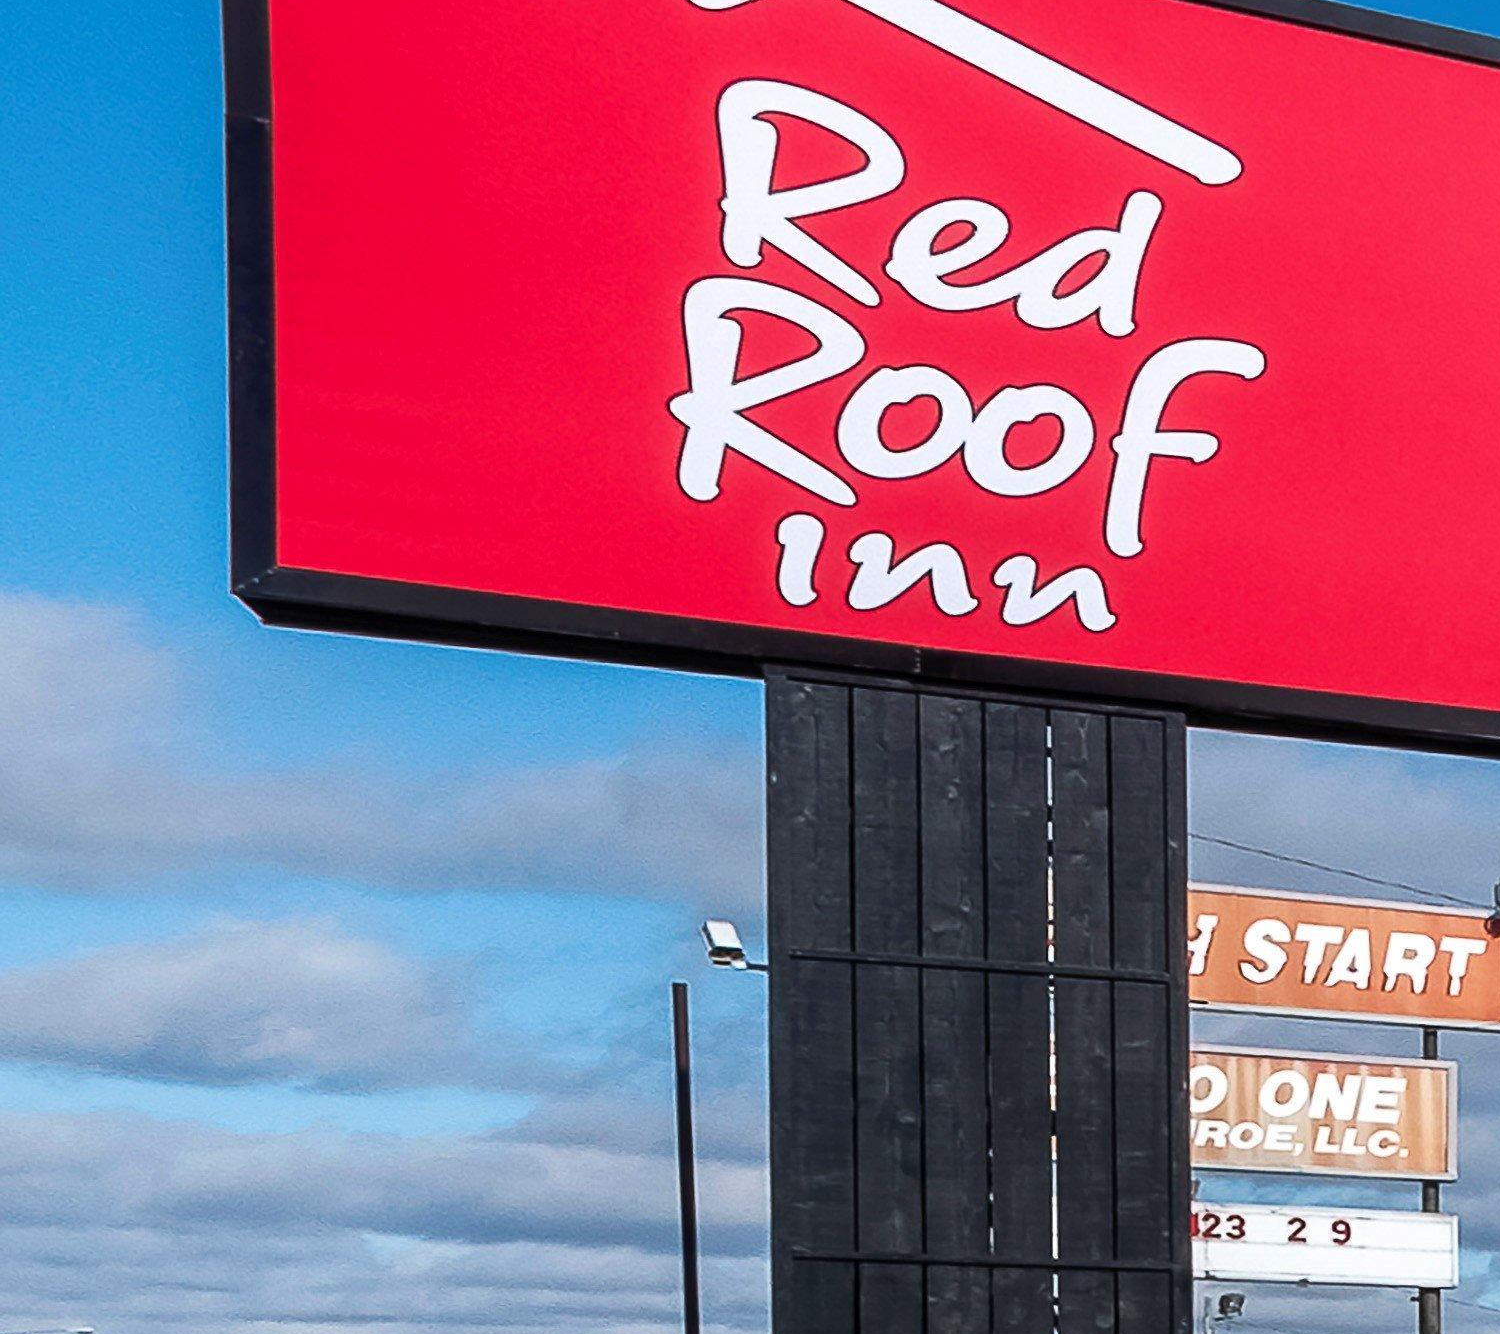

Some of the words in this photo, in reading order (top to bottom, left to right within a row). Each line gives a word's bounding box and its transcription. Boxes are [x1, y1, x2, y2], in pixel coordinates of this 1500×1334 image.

[718, 79, 1163, 338] Red
[669, 276, 1266, 558] Roof
[1238, 917, 1488, 997] START
[1258, 1069, 1408, 1125] ONE
[1190, 1118, 1305, 1157] ROE,
[1312, 1124, 1410, 1159] LLC.
[1286, 1216, 1308, 1243] 2
[1330, 1218, 1352, 1246] 9
